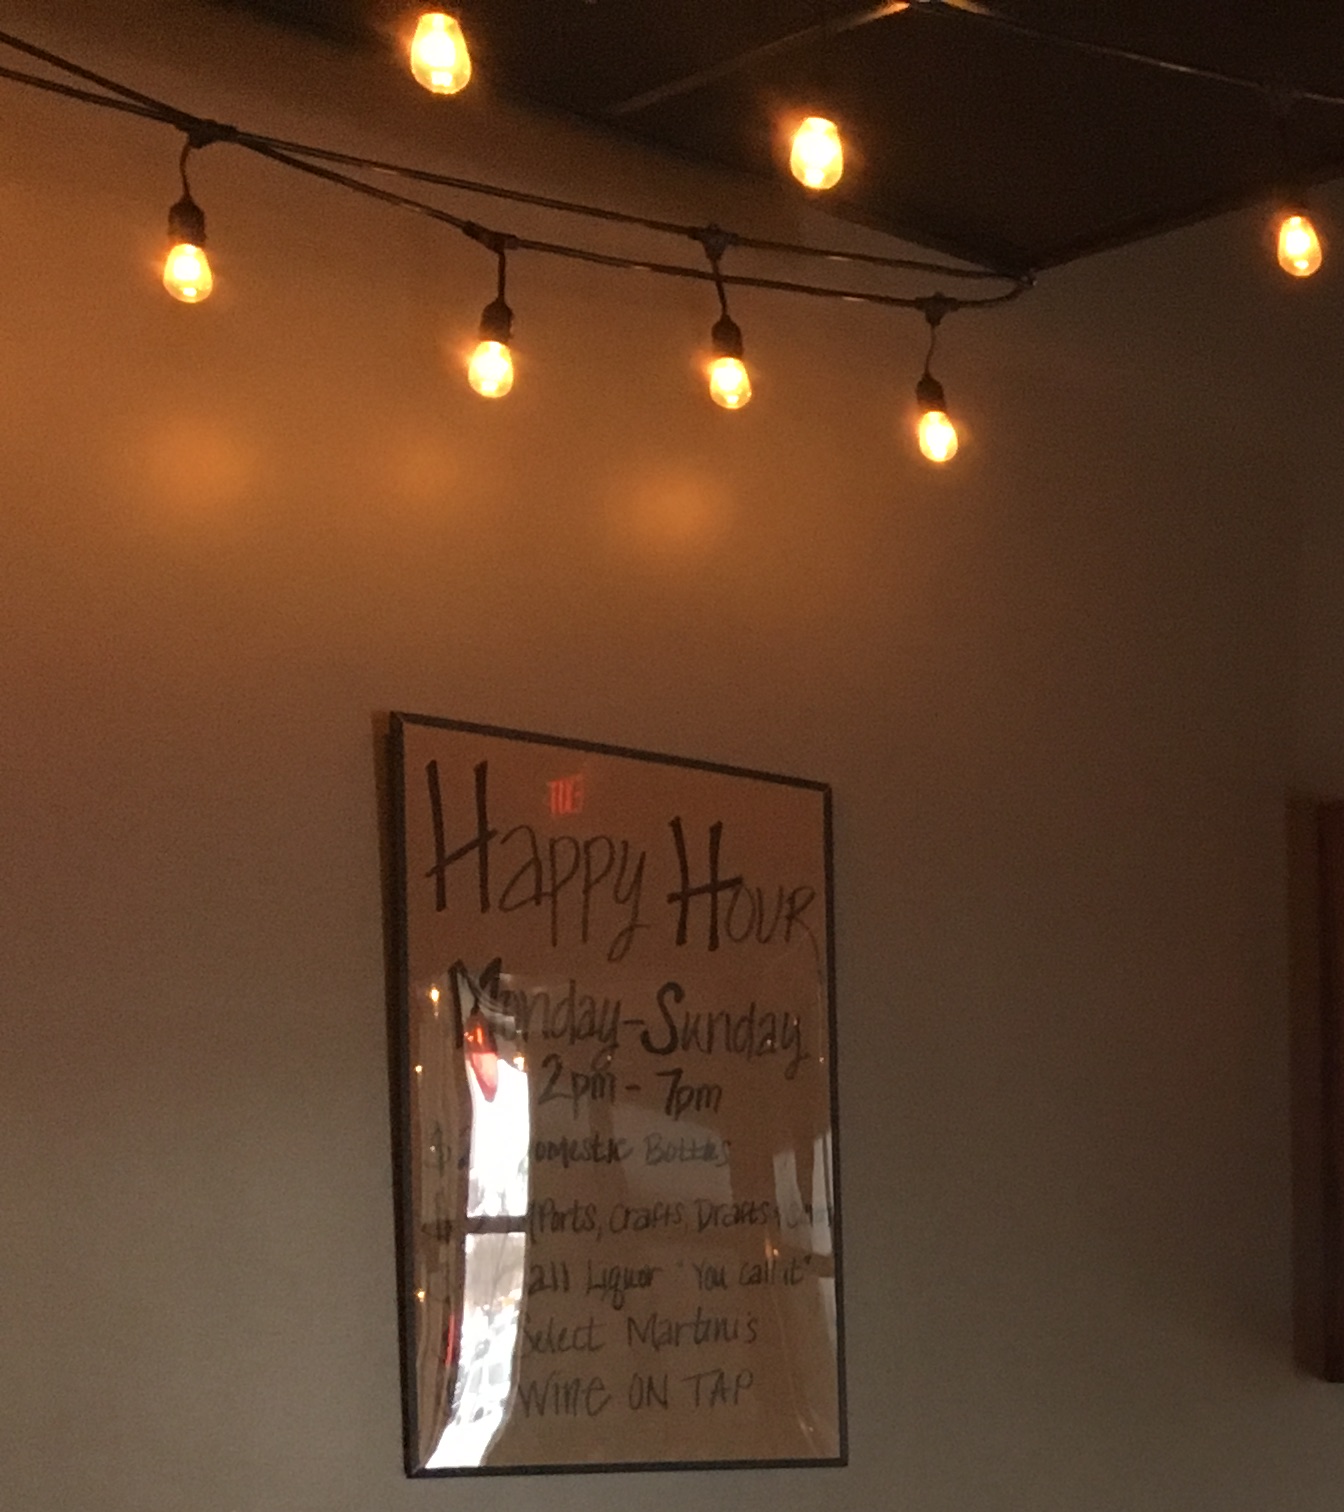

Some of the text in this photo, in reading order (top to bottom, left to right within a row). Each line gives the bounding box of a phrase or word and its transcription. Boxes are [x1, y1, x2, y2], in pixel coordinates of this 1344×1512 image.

[424, 758, 651, 963] Happy
[538, 1053, 618, 1122] 2pm
[657, 1068, 724, 1122] 7pm
[516, 1130, 634, 1171] omestic
[628, 1372, 670, 1411] ON
[681, 1368, 756, 1408] TAP
